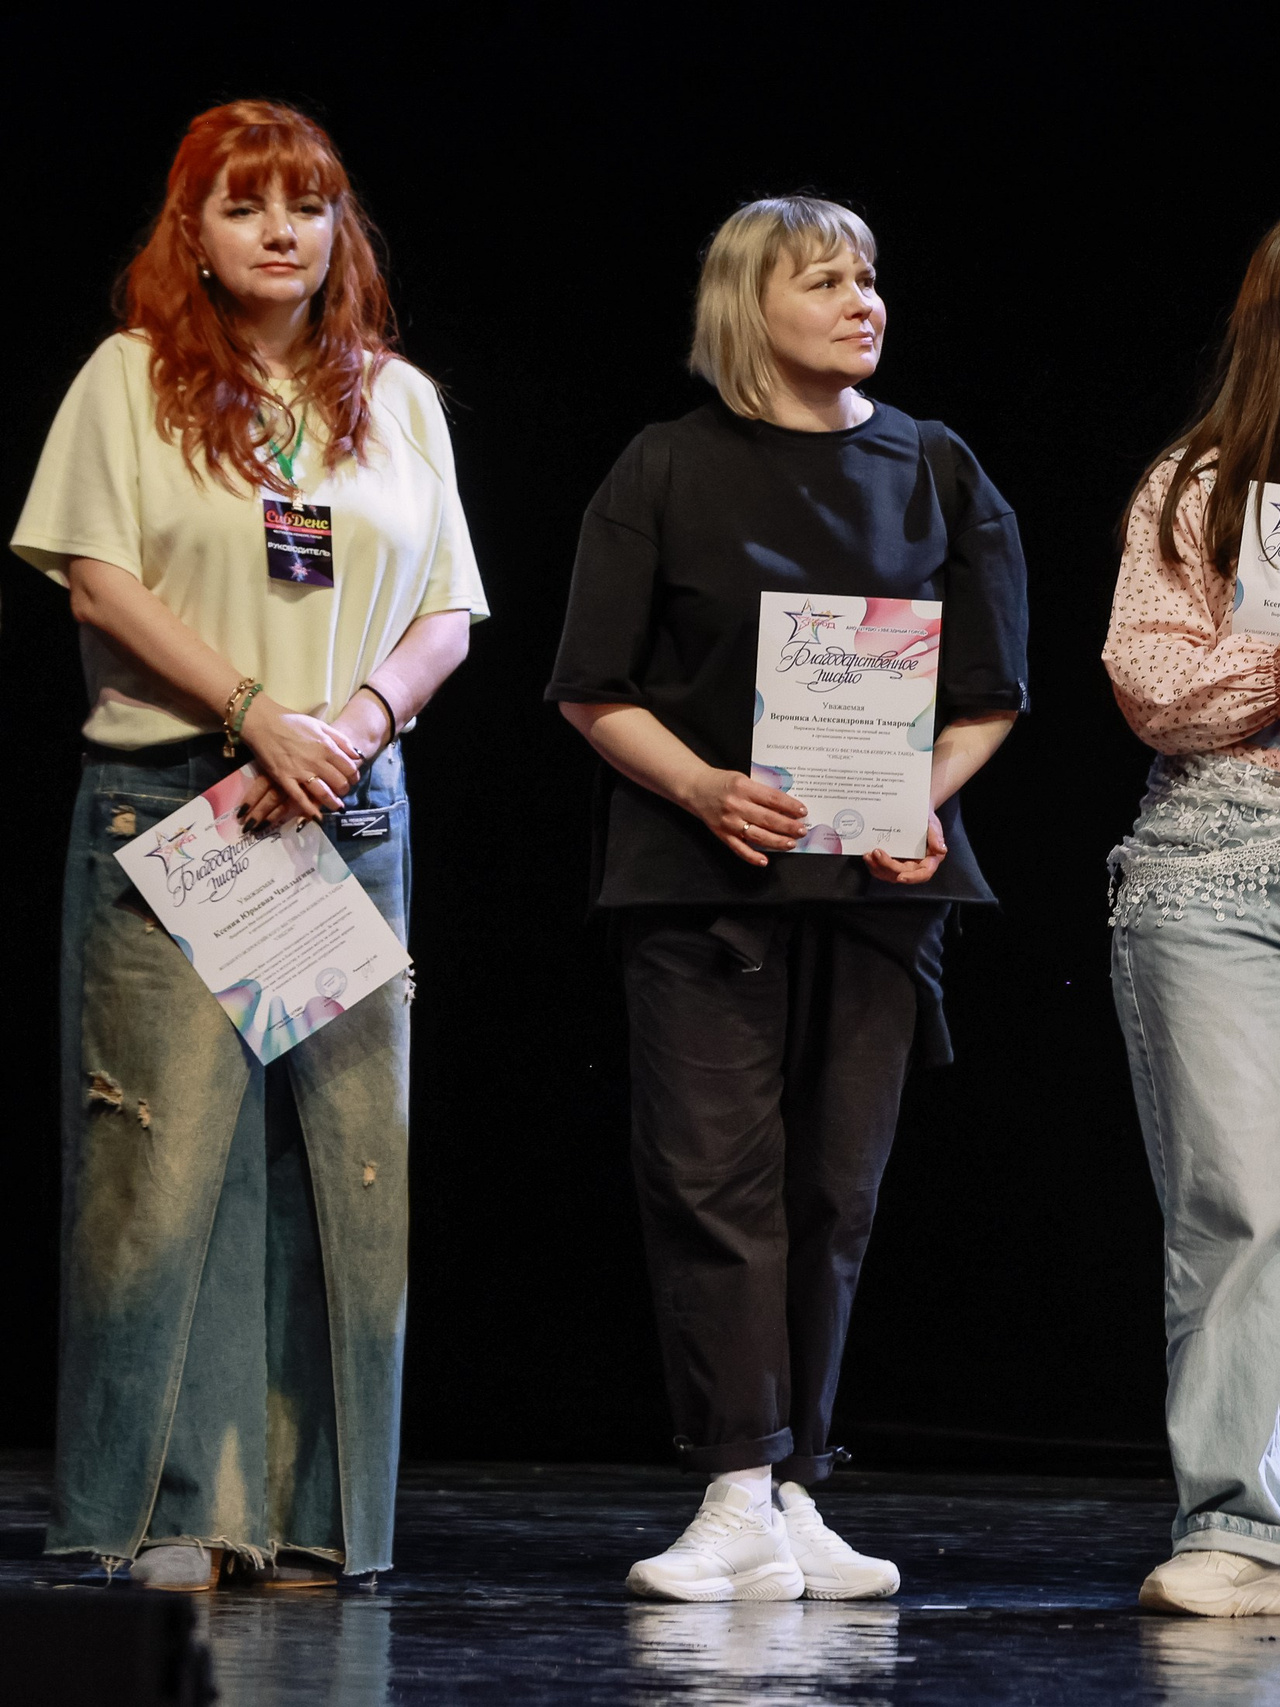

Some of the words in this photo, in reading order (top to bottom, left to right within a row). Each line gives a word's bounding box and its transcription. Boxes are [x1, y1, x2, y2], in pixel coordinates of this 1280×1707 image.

[266, 509, 329, 529] СибДенс
[267, 542, 331, 557] РУКОВОДИТЕЛЬ
[776, 640, 918, 675] Благодарственное
[822, 702, 865, 711] Уважаемая
[770, 712, 810, 723] Вероника
[811, 715, 874, 726] Александровна
[876, 718, 916, 729] Тамарова
[167, 824, 276, 907] Благодарст
[213, 919, 241, 938] Ксения
[240, 895, 274, 920] Юрьевна
